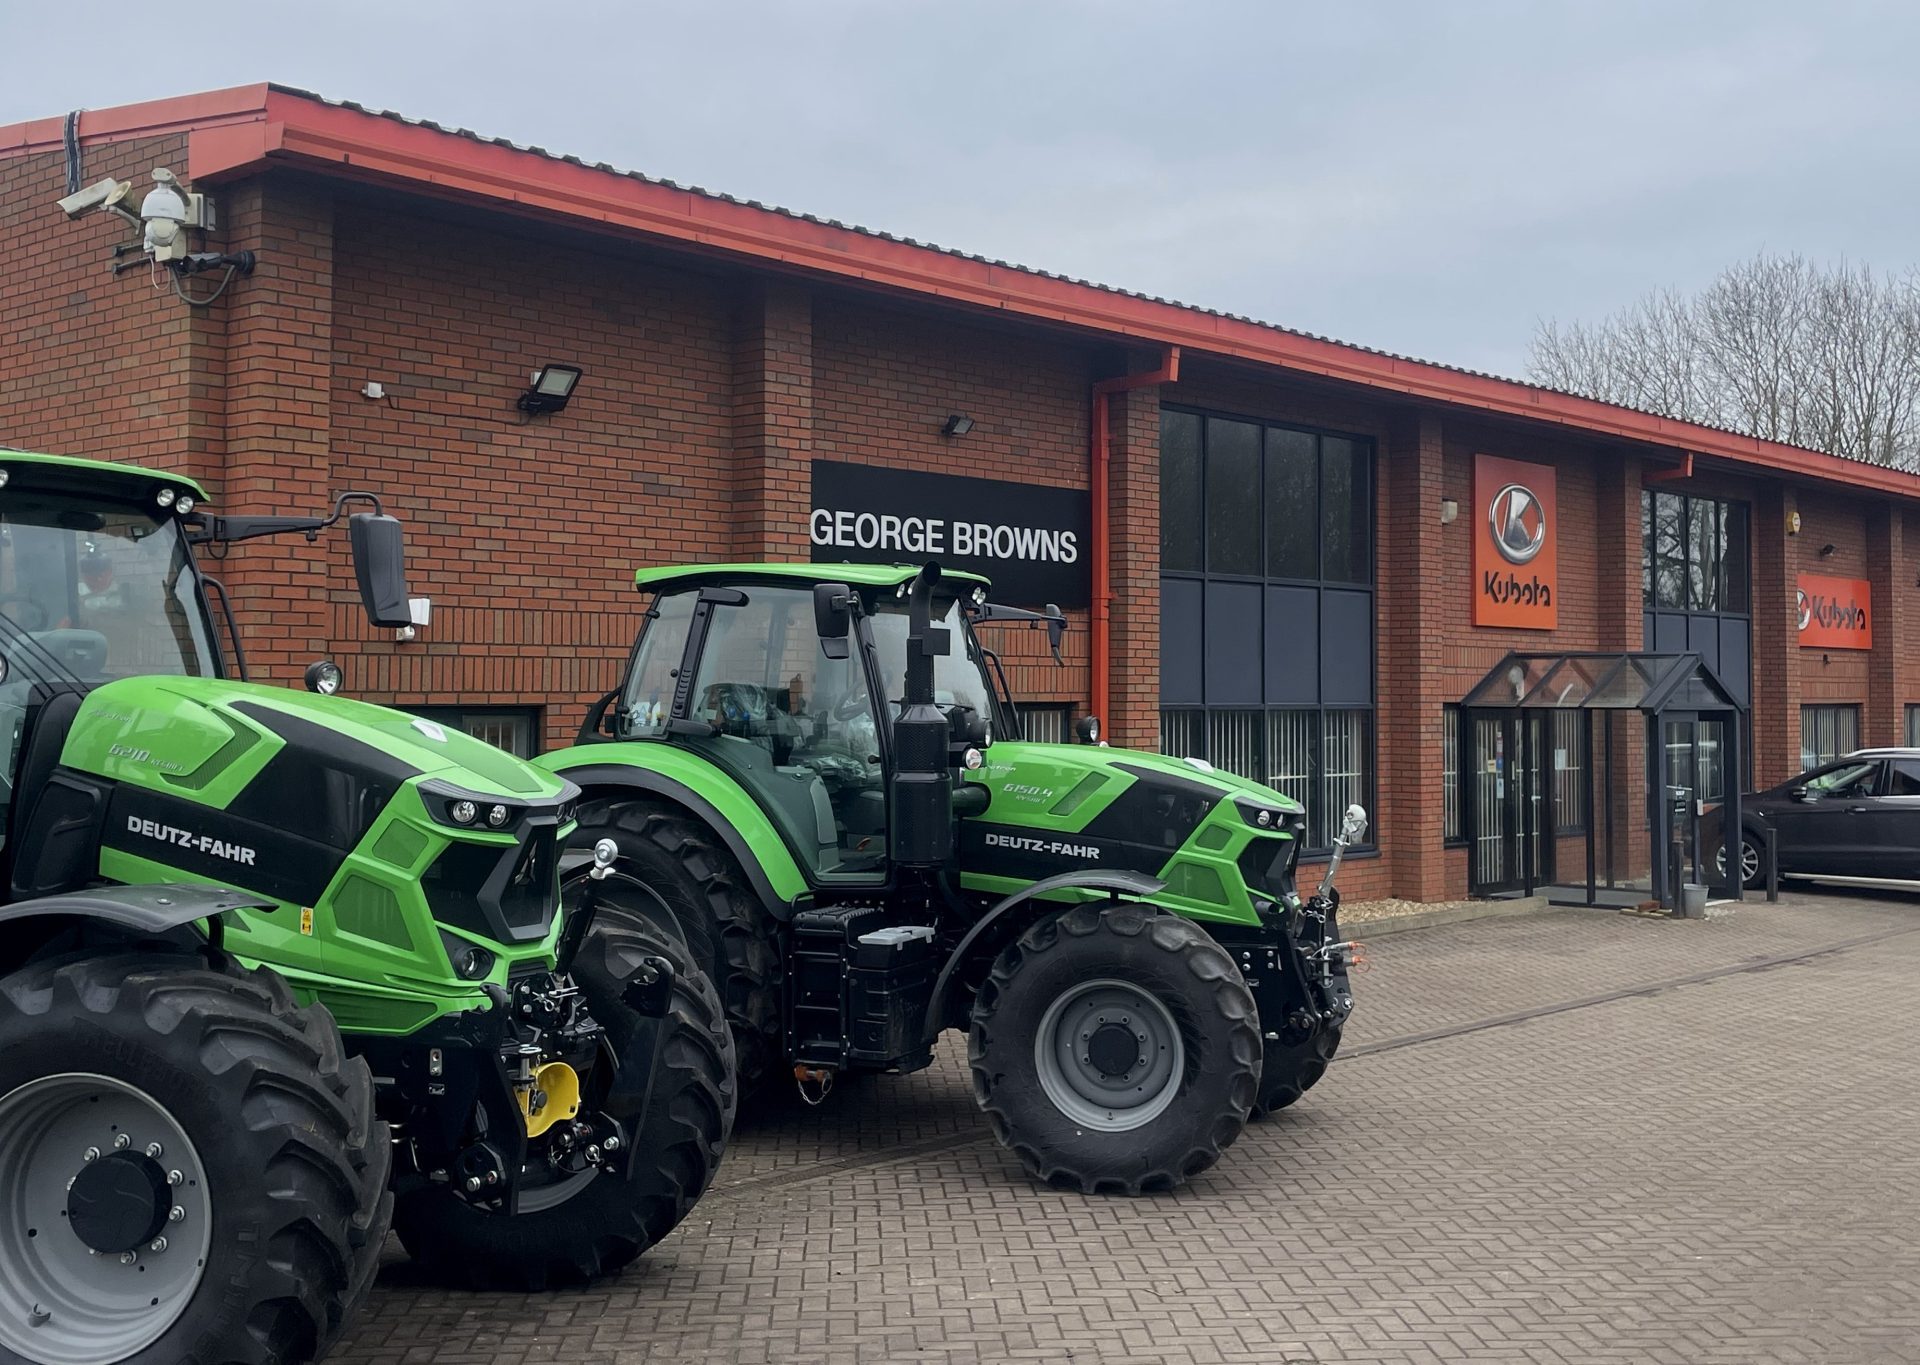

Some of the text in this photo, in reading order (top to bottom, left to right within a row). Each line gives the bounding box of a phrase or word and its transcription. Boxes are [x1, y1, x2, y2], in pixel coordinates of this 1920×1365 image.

[810, 508, 1077, 564] GEORGE BROWNS
[1484, 570, 1550, 606] Kubota
[1812, 595, 1866, 630] Kubota
[127, 815, 256, 866] DEUTZ-FAHR
[985, 833, 1100, 860] DEUTZ-FAHR
